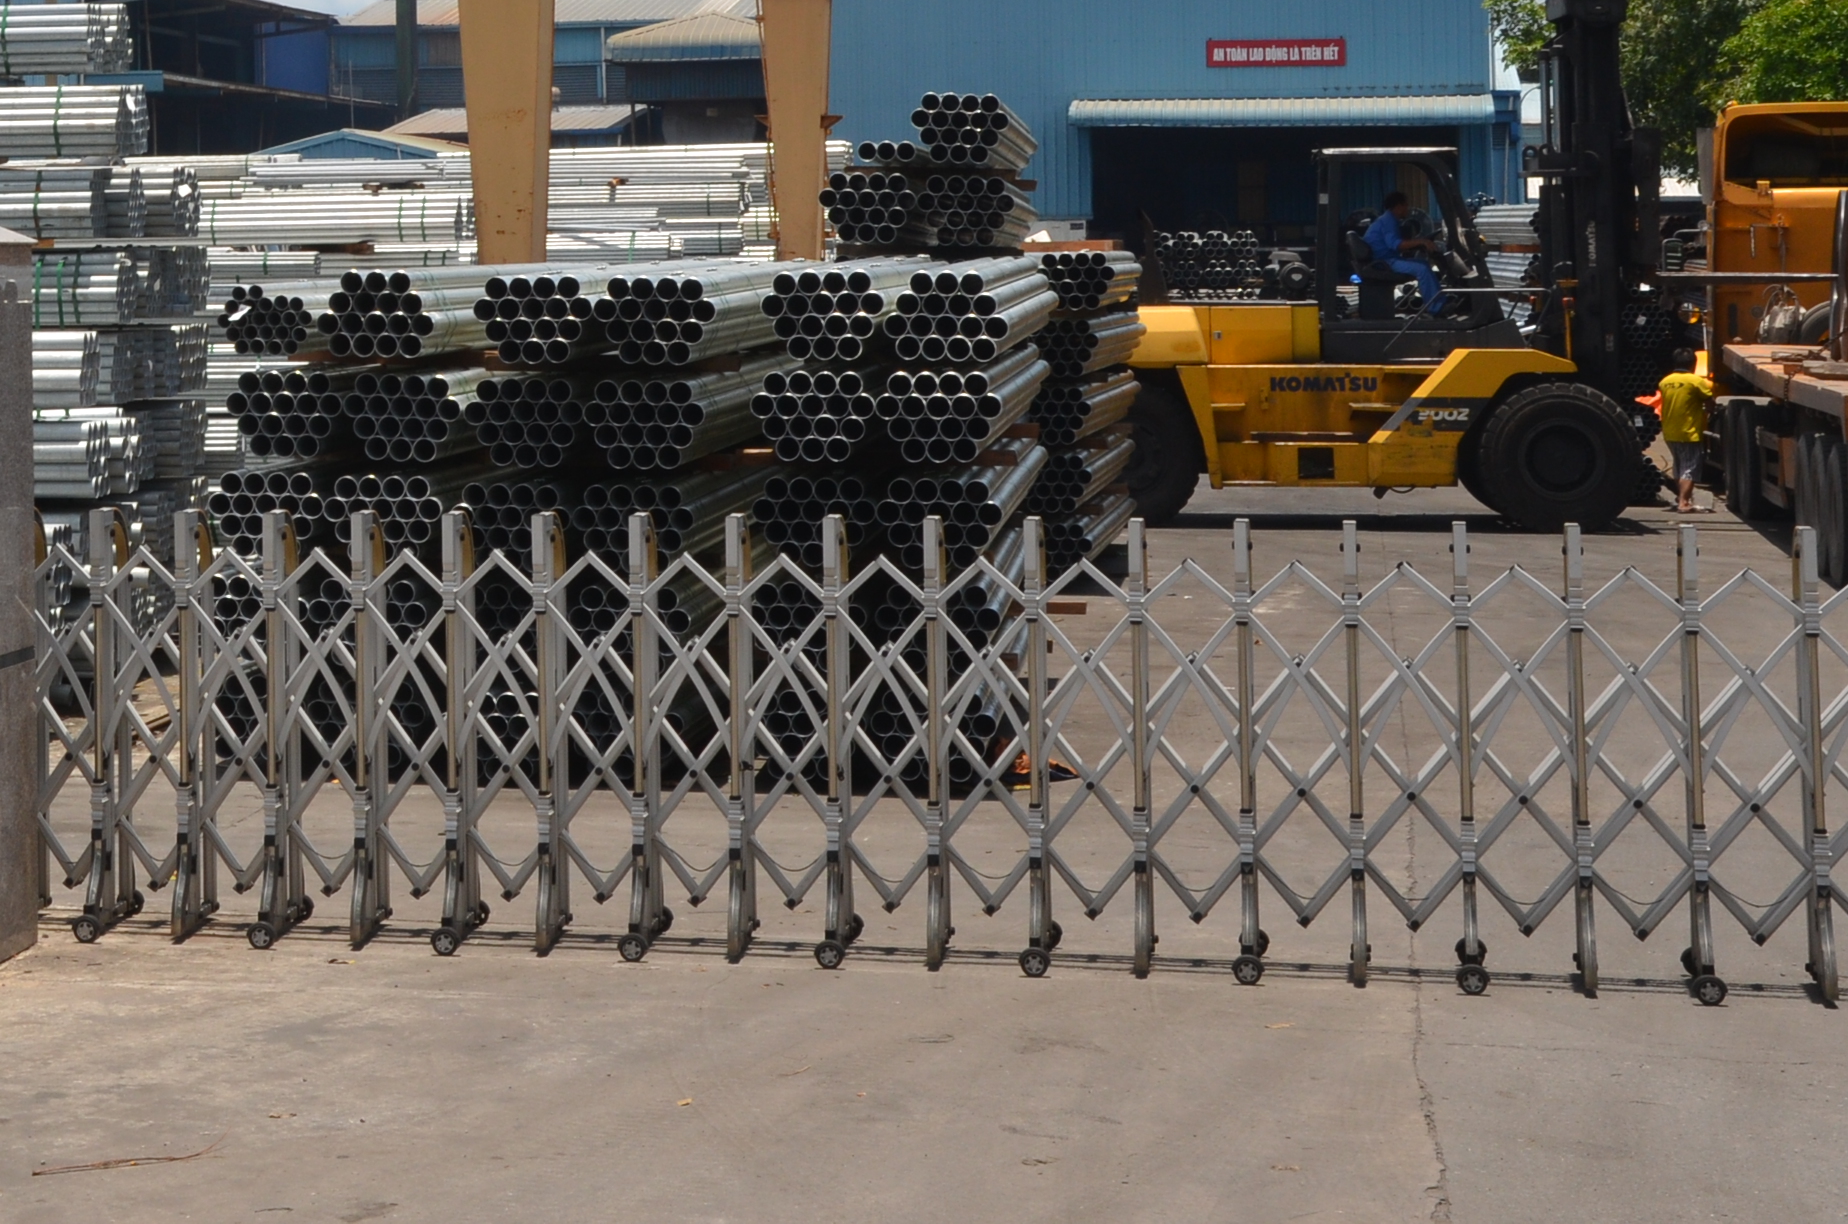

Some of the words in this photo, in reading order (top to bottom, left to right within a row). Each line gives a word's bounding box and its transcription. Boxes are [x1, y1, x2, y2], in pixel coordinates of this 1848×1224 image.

[1213, 48, 1224, 61] AN
[1249, 47, 1263, 61] LAO
[1290, 45, 1299, 60] LÀ
[1270, 373, 1377, 392] KOMATSU
